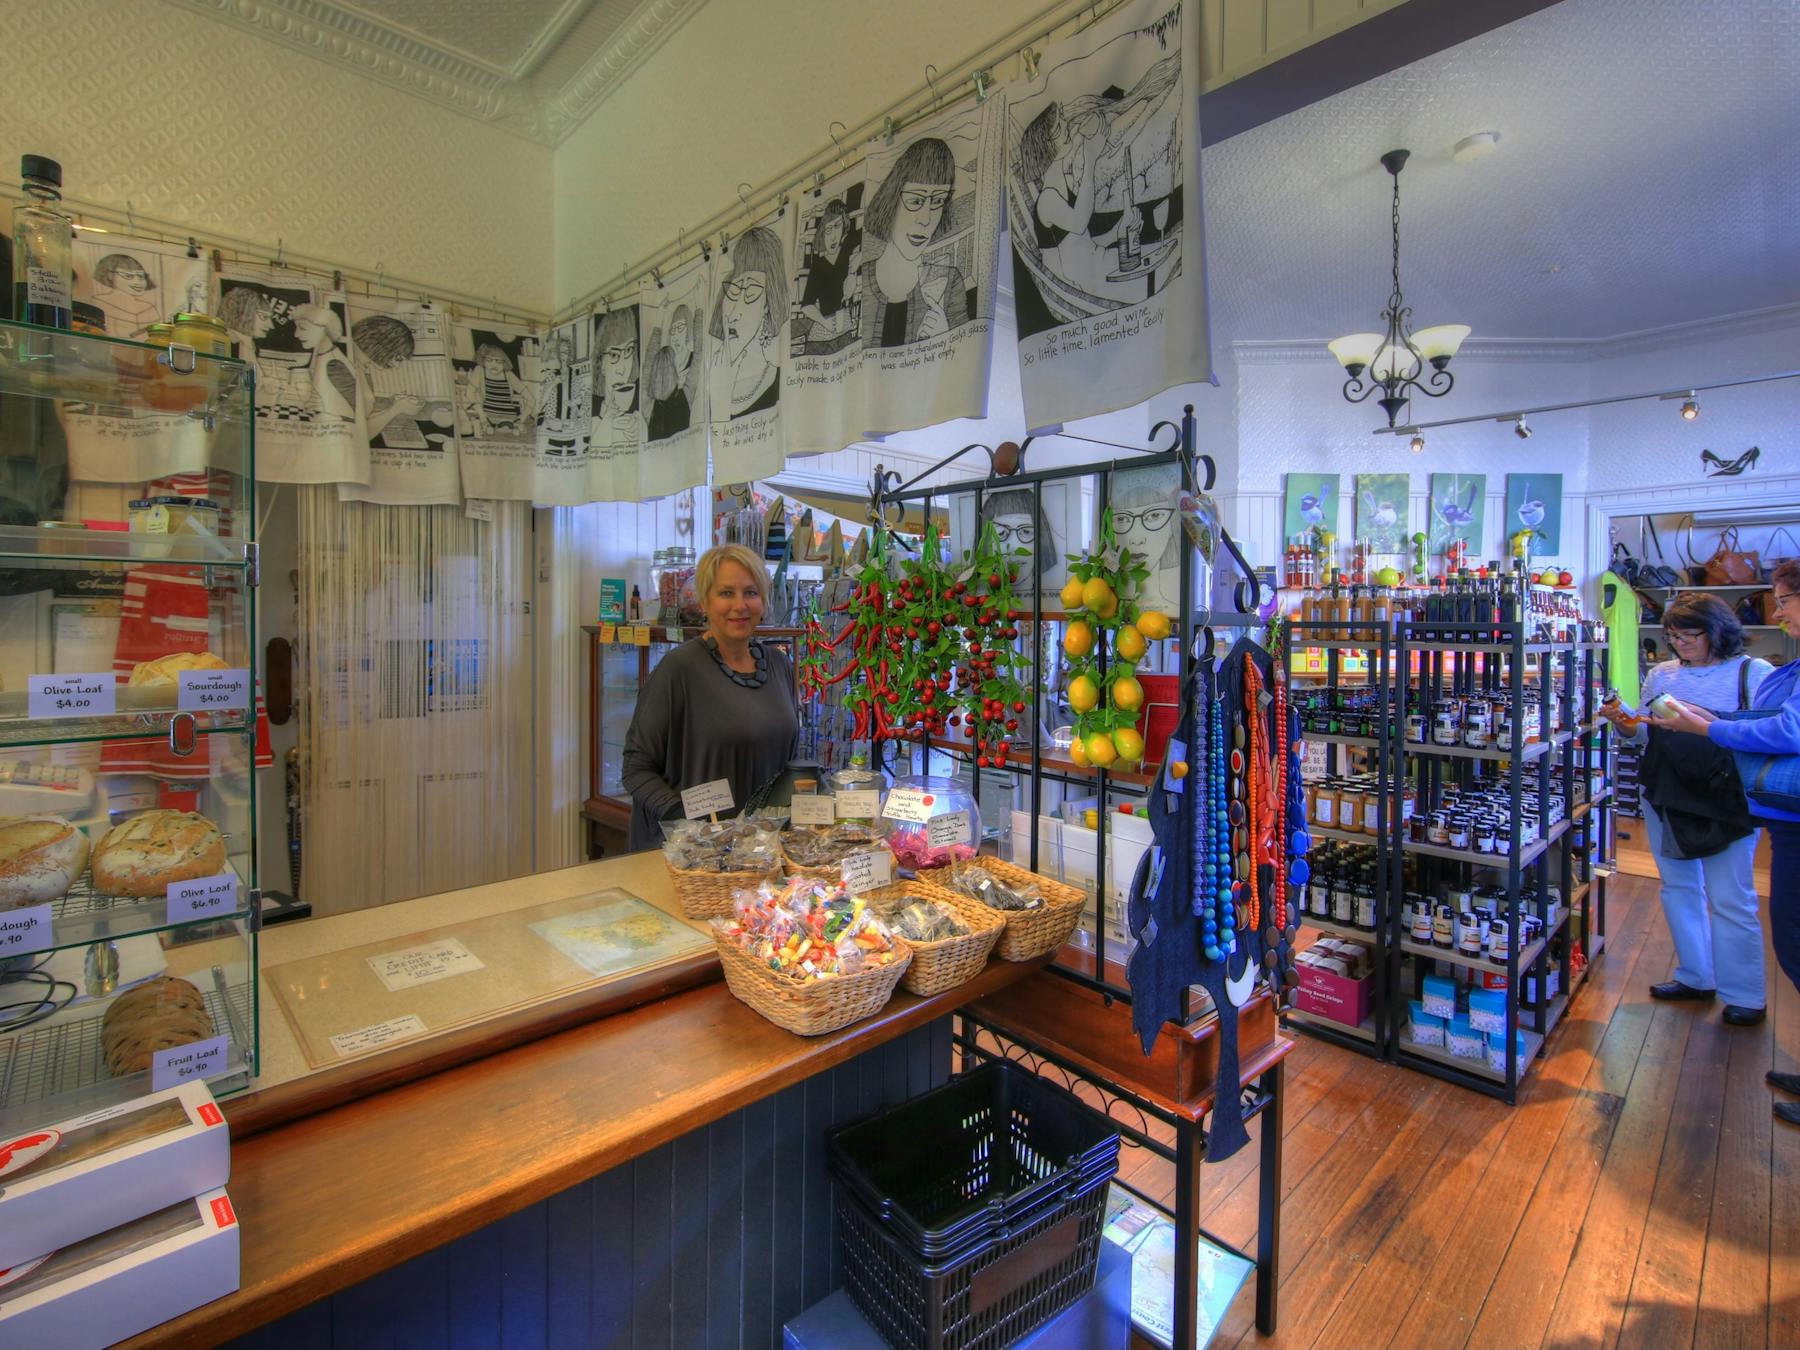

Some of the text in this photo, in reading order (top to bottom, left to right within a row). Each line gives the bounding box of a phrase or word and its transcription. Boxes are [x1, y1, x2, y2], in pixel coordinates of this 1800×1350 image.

[969, 324, 988, 338] glass
[1061, 318, 1087, 339] much
[1093, 312, 1118, 336] good
[1024, 353, 1035, 366] So
[1038, 345, 1058, 361] little
[1090, 320, 1140, 347] lamented
[795, 358, 819, 372] Unable
[822, 360, 831, 370] to
[881, 363, 896, 371] was
[807, 372, 829, 384] made
[43, 684, 104, 695] Olive Loaf
[187, 681, 242, 692] Sourdough
[56, 699, 91, 709] $4.00
[200, 694, 229, 703] $4.00
[890, 793, 921, 802] Chocolate
[946, 814, 960, 822] Lady
[181, 882, 232, 898] Olive Loaf
[192, 898, 220, 910] $6.90
[168, 1046, 220, 1067] Fruit Loaf
[178, 1063, 208, 1077] $6.90
